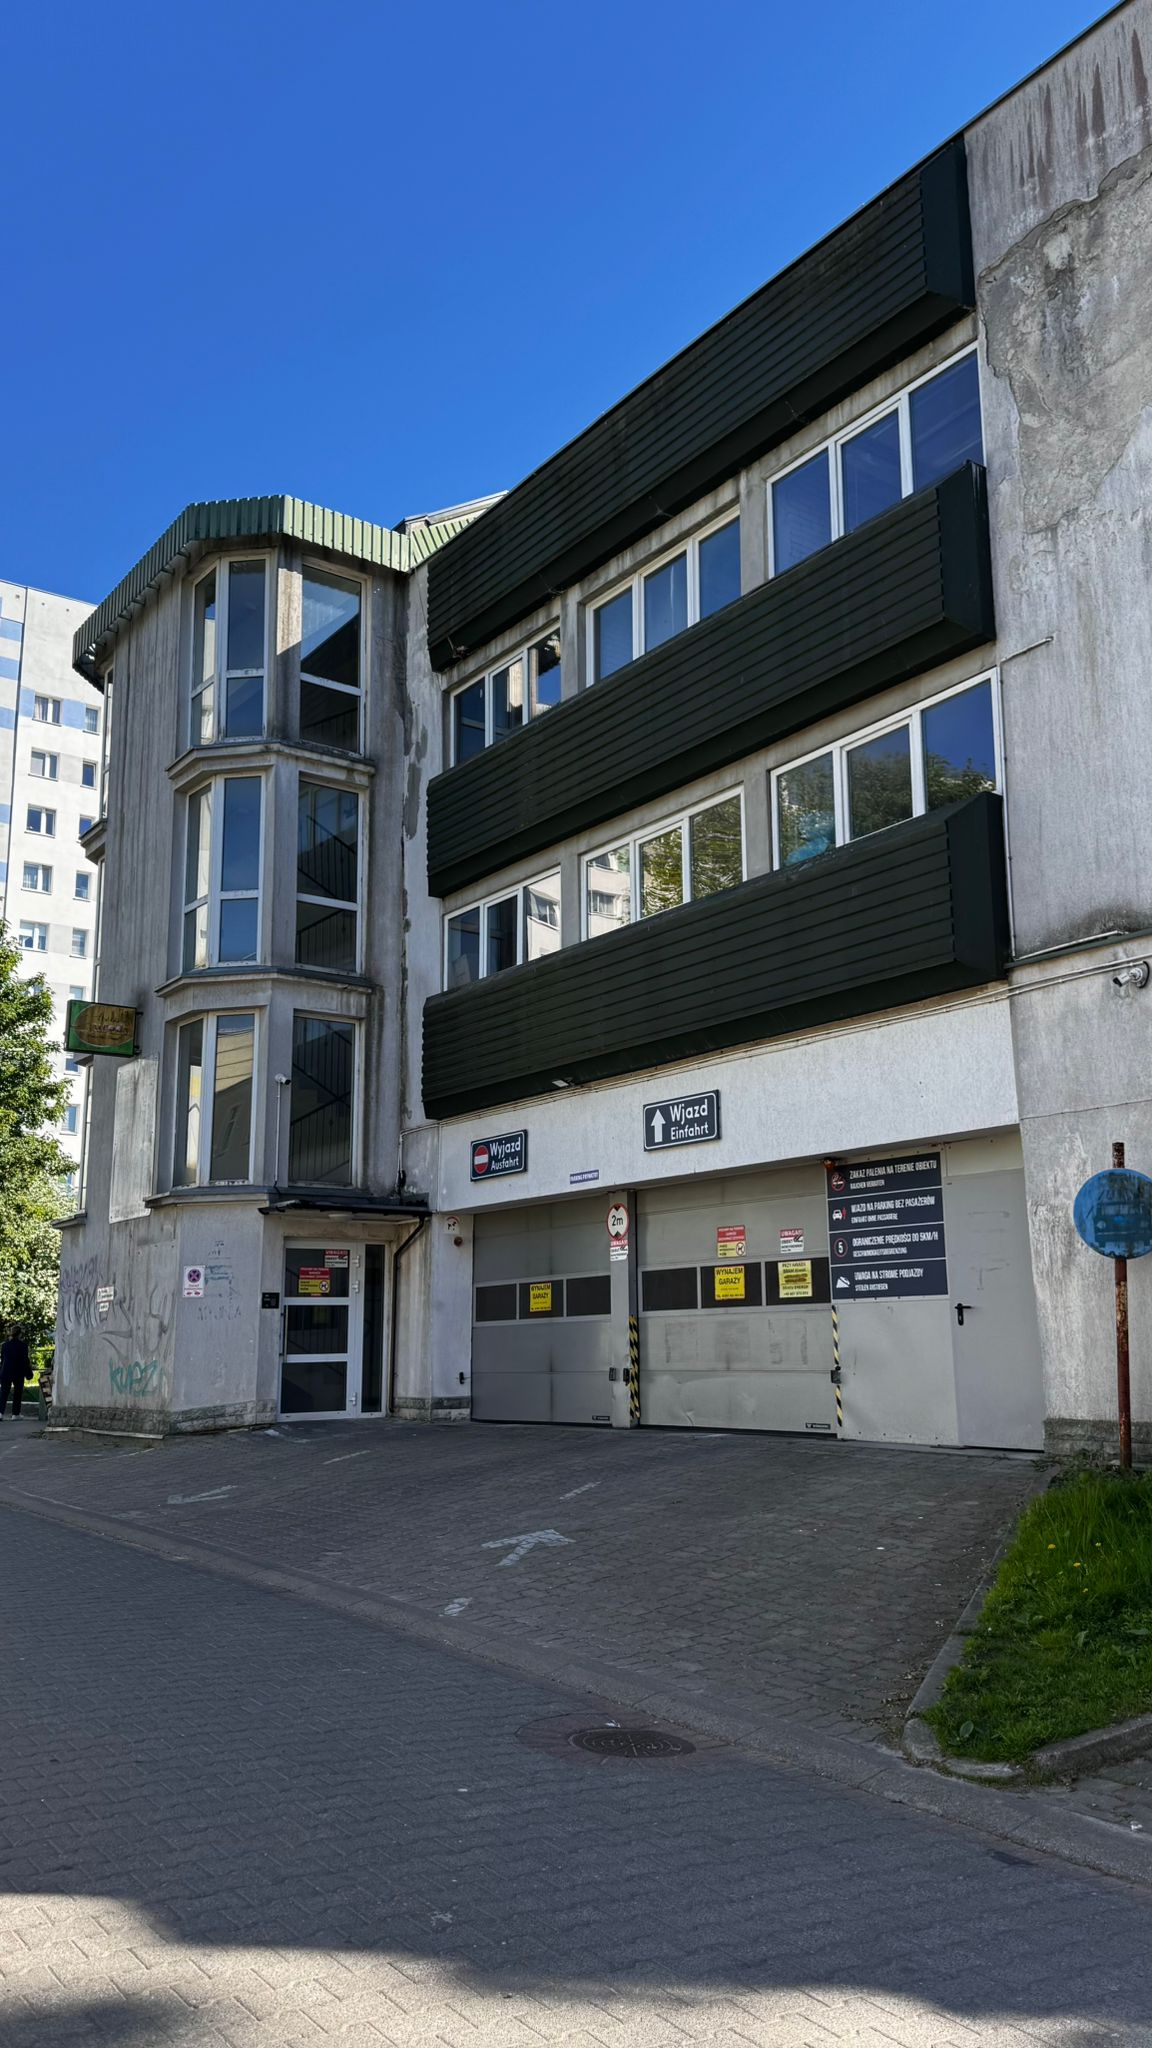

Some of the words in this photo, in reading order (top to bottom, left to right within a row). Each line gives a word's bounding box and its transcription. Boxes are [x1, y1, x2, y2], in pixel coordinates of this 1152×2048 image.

[669, 1098, 708, 1125] Wjazd
[670, 1121, 709, 1140] Einfahrt
[490, 1136, 521, 1159] Wyjazd
[491, 1156, 519, 1171] Ausfahrt
[849, 1169, 866, 1180] ZAKAZ
[866, 1166, 887, 1177] PALENIA
[887, 1165, 894, 1174] NA
[894, 1162, 915, 1173] TERENIE
[915, 1160, 937, 1171] OBIEKTU
[867, 1202, 874, 1211] NA
[874, 1200, 895, 1210] PARKING
[895, 1199, 905, 1208] BEZ
[905, 1195, 935, 1207] PASAŻERÓW
[611, 1215, 624, 1226] 2m
[852, 1235, 885, 1247] OGRANICZENIE
[912, 1233, 919, 1242] DO
[920, 1231, 939, 1241] 5KM/H
[838, 1241, 844, 1254] 5
[854, 1271, 871, 1280] UWAGA
[871, 1270, 879, 1280] NA
[879, 1269, 898, 1279] STROME
[899, 1268, 923, 1278] PODJAZDY
